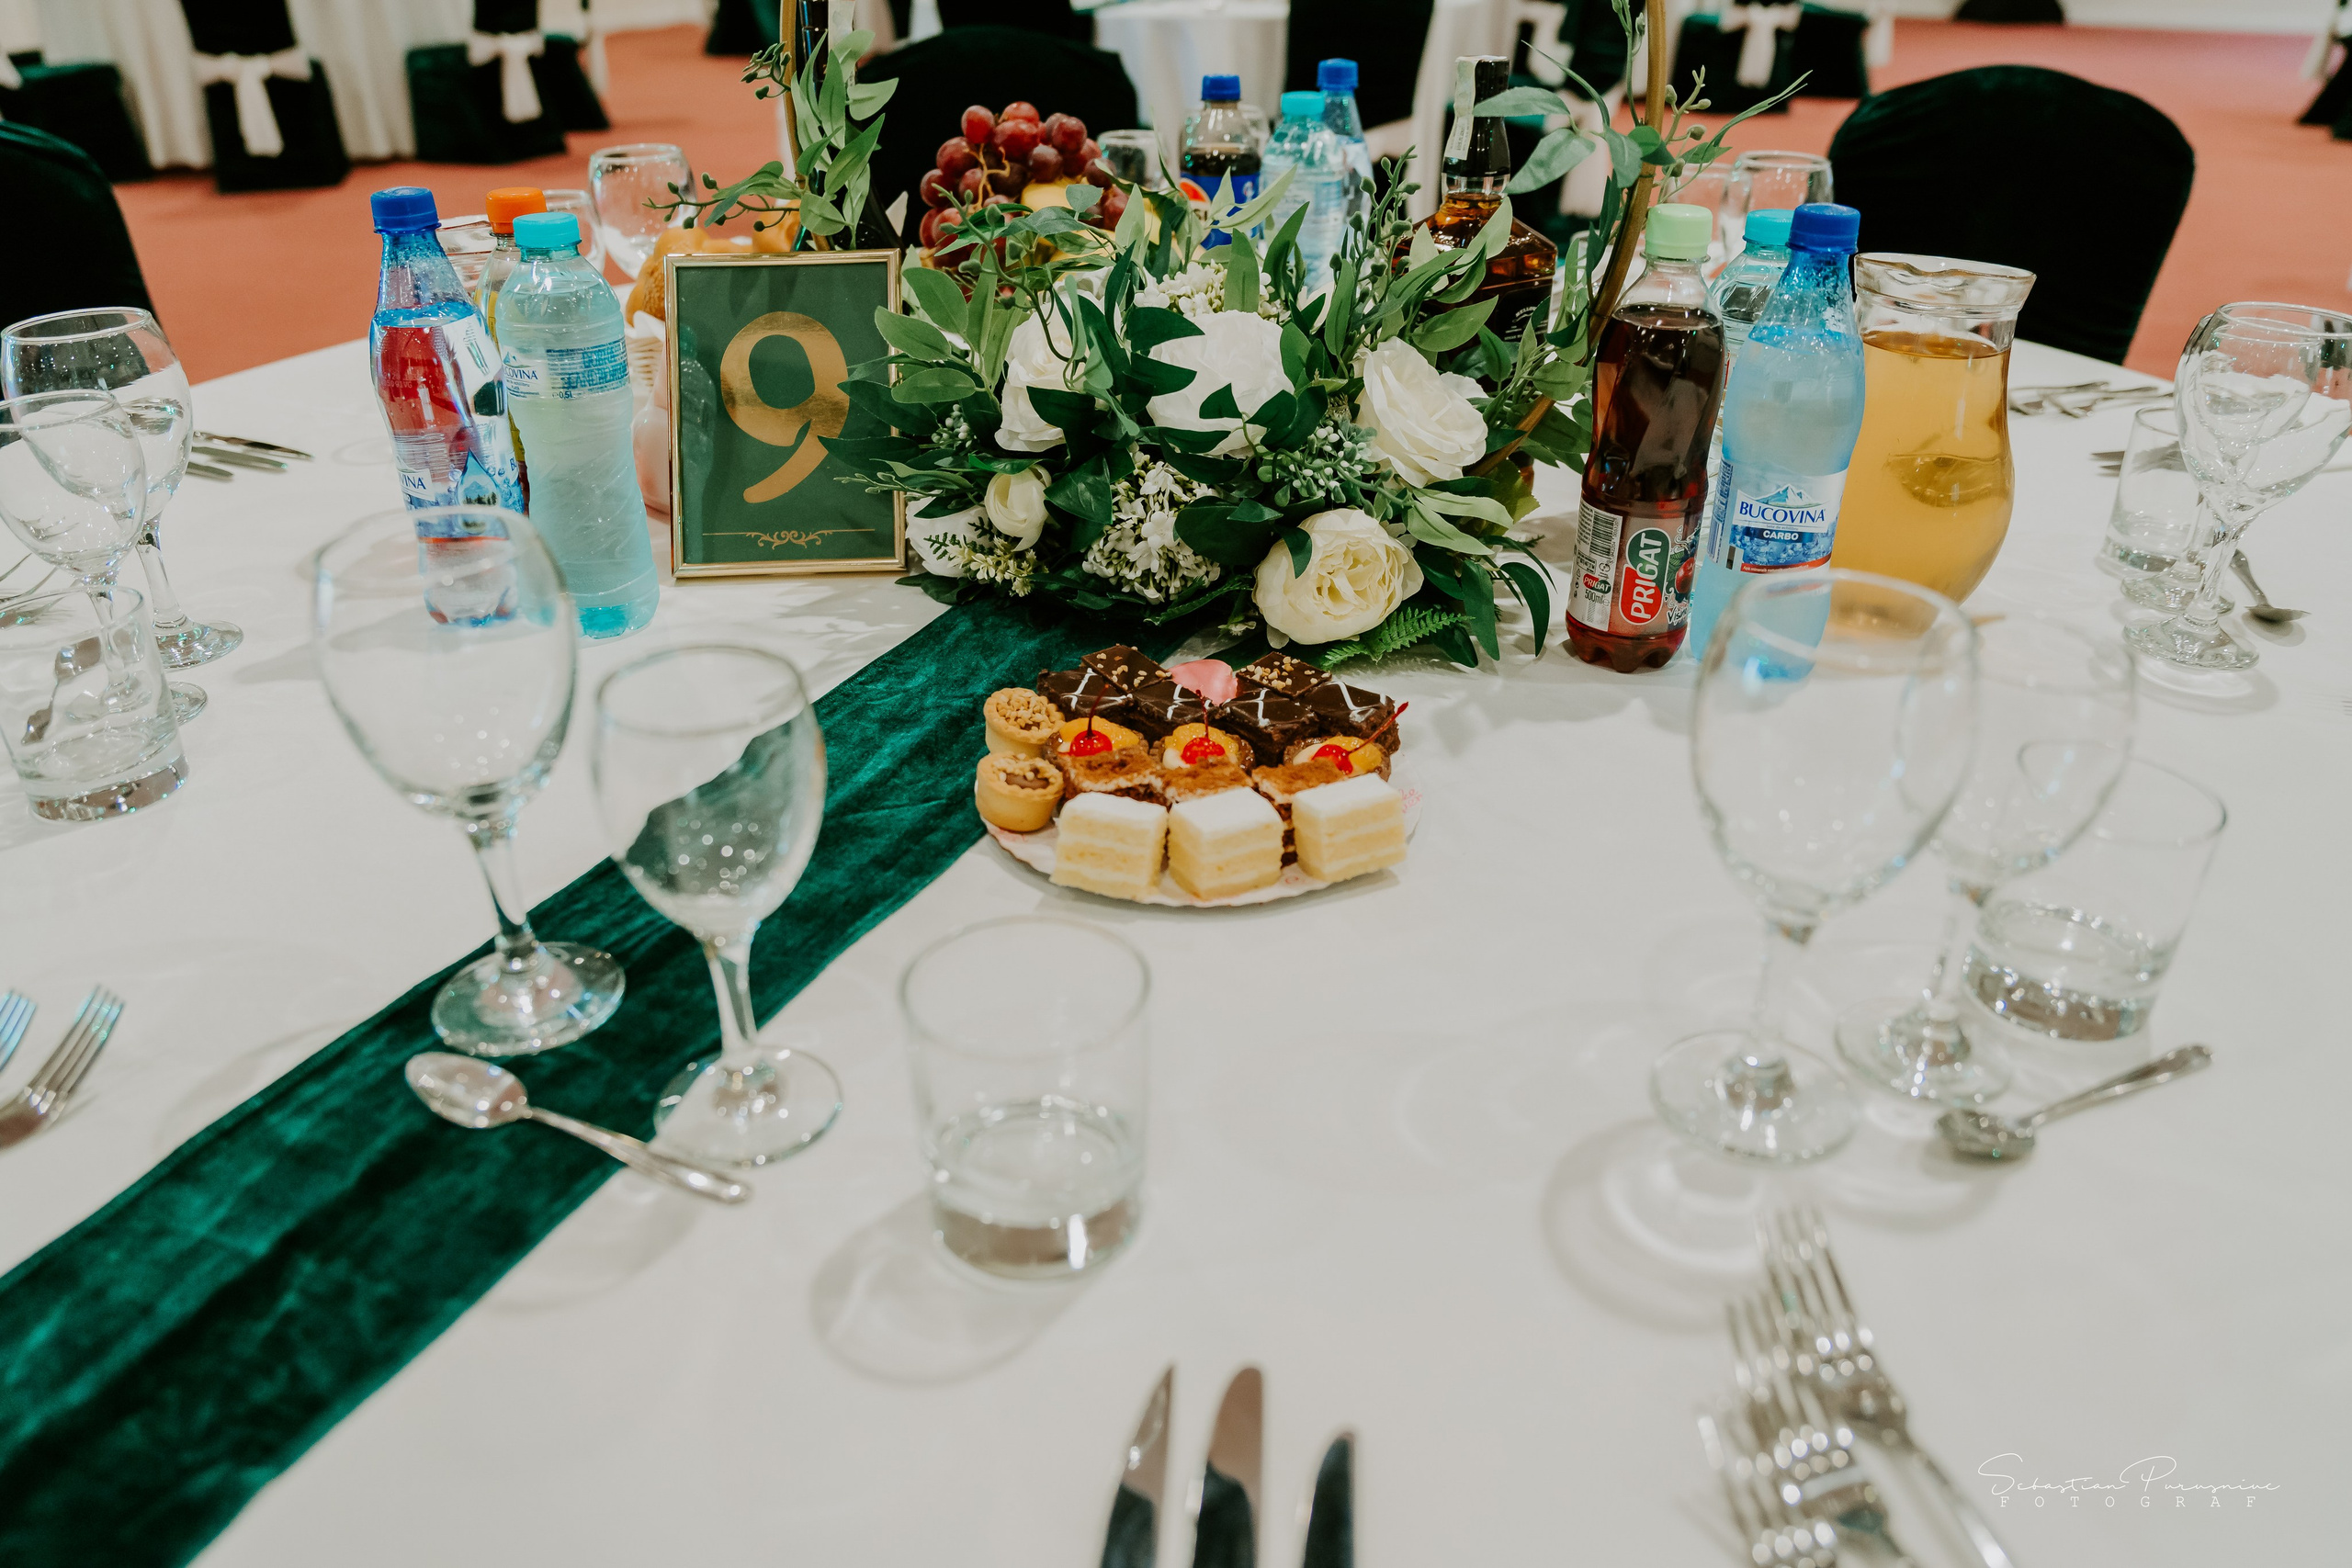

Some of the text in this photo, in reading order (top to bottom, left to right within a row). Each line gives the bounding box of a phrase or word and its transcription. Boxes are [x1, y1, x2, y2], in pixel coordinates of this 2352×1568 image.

[504, 367, 538, 380] COVINA
[720, 310, 850, 503] 9
[401, 474, 426, 491] VINA
[1739, 501, 1826, 524] BUCOVINA
[1762, 530, 1799, 541] CARBO
[1583, 576, 1610, 592] PRIGAT
[1630, 532, 1662, 619] PRIGAT
